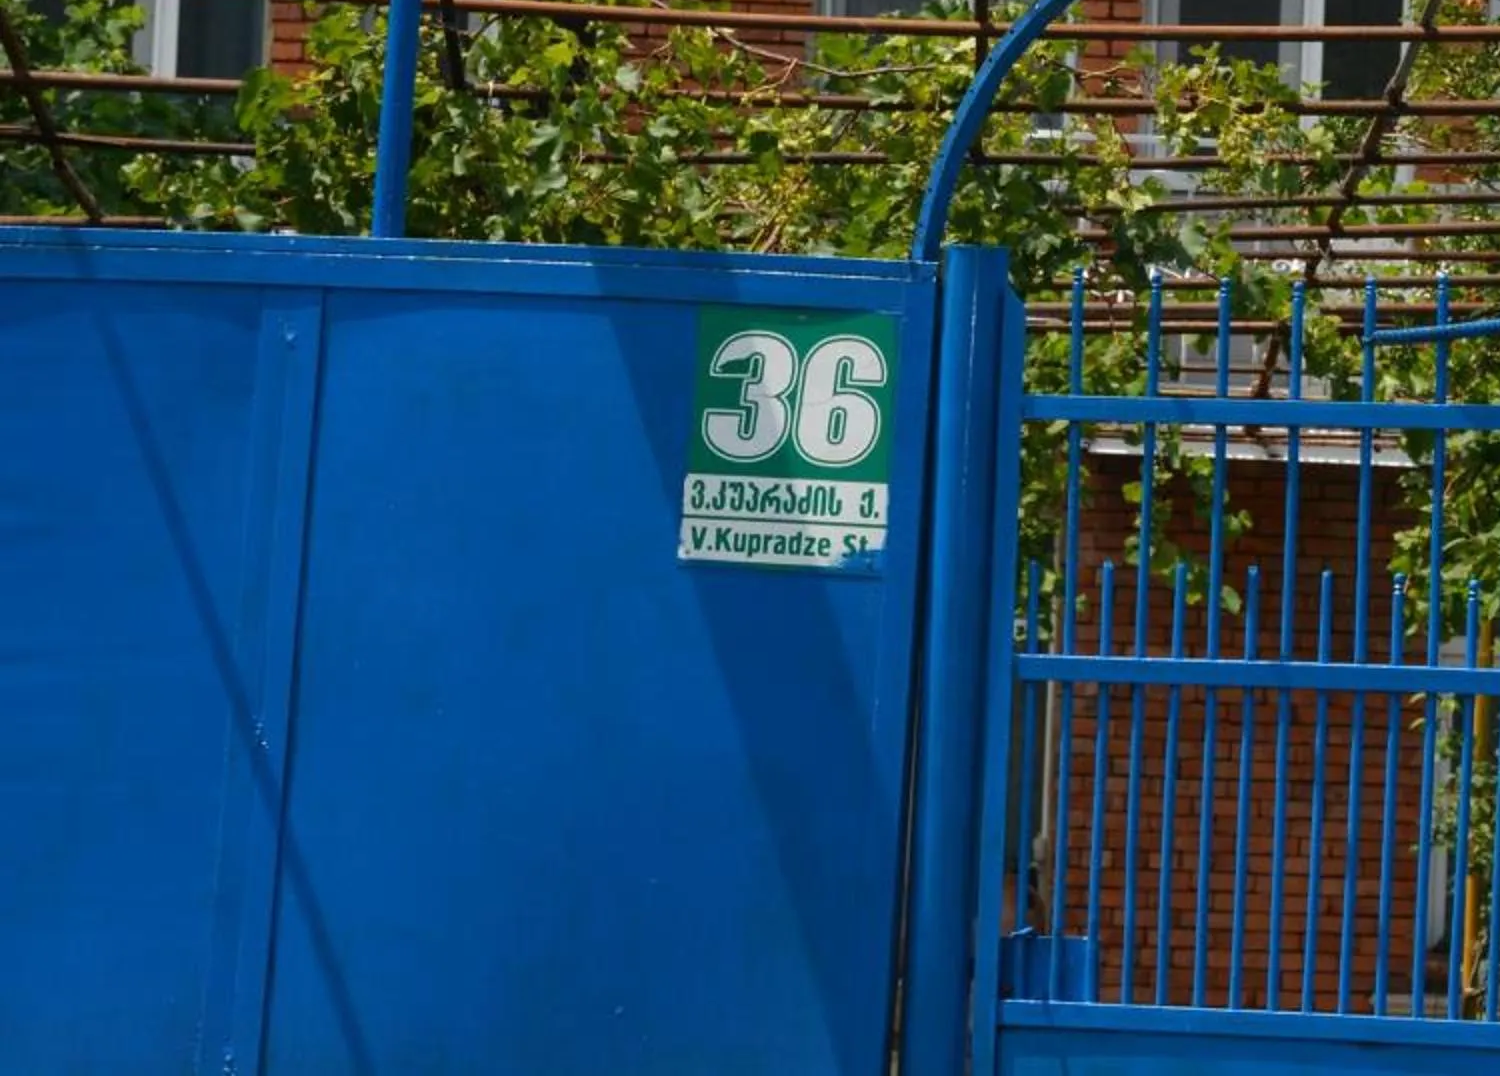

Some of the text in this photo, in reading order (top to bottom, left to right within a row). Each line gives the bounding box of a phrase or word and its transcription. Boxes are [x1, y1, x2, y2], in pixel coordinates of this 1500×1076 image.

[701, 330, 888, 469] 36
[690, 480, 842, 518] ვ.კუპრაძის
[690, 526, 832, 559] V.Kupradze
